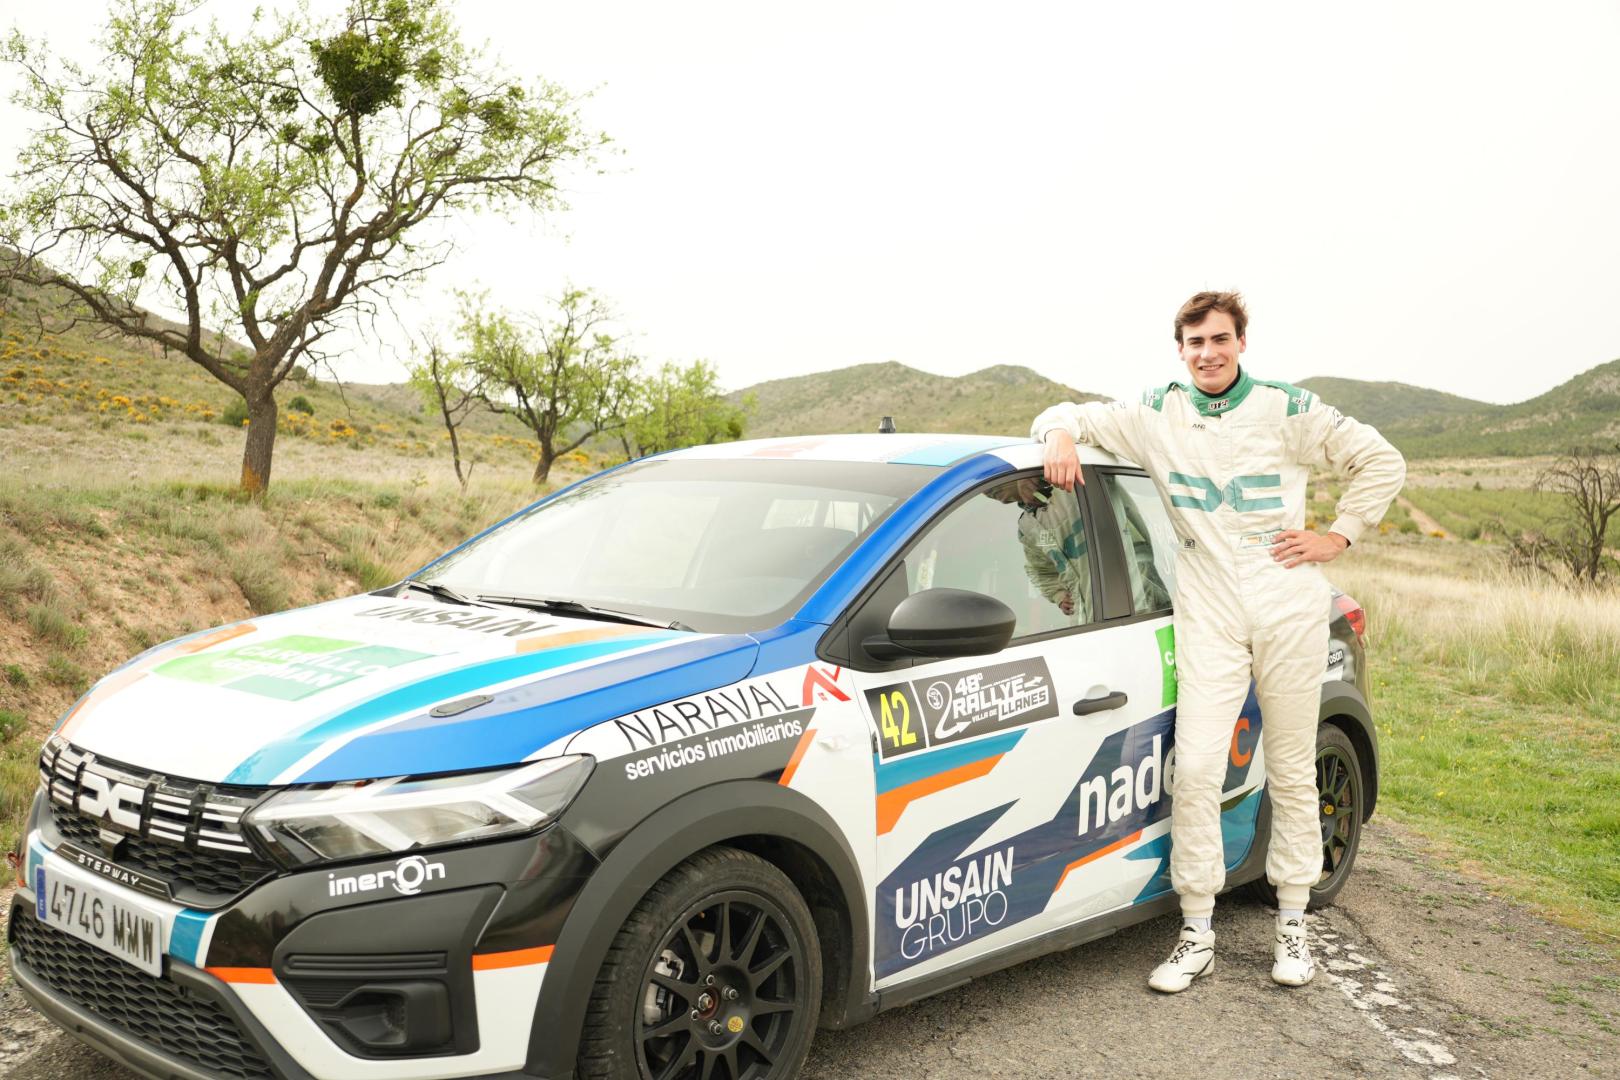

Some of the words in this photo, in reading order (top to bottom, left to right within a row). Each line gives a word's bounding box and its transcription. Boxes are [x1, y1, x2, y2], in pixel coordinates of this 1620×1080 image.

[353, 605, 560, 637] UNSAIN
[613, 681, 800, 752] NARAVAL
[880, 691, 917, 748] 42
[952, 677, 1025, 720] RALLYE
[1001, 690, 1047, 716] LLANES
[624, 743, 706, 781] servicios
[705, 716, 803, 759] inmobiliarios
[77, 853, 140, 886] STEPWAY
[894, 846, 1014, 930] UNSAIN
[51, 881, 105, 940] 4746
[113, 904, 154, 965] MMW
[899, 890, 1008, 960] GRUPO
